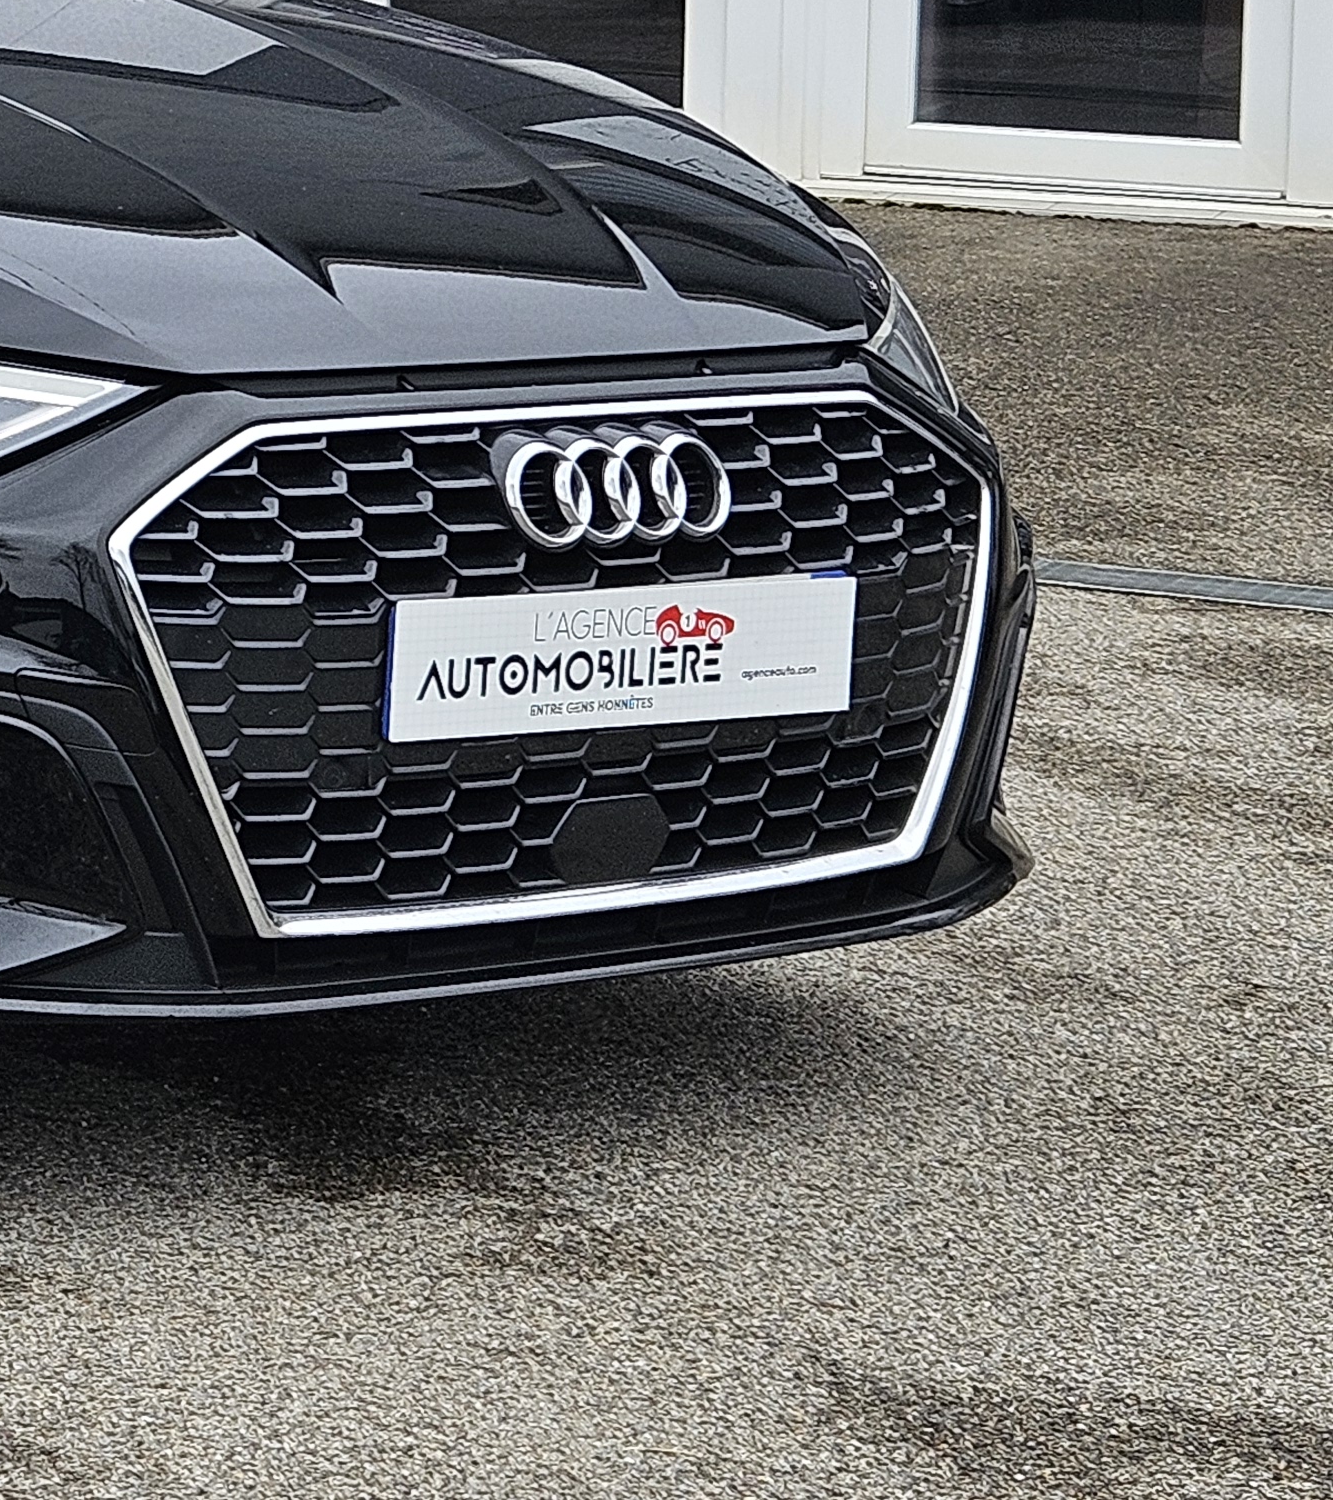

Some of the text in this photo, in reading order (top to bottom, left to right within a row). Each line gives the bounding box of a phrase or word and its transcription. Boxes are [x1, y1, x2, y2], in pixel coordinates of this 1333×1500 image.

[533, 606, 658, 643] L'AGENCE
[416, 643, 724, 701] AUTOMOBILIERE
[530, 694, 654, 717] ENTRE GENS HONNÊTES
